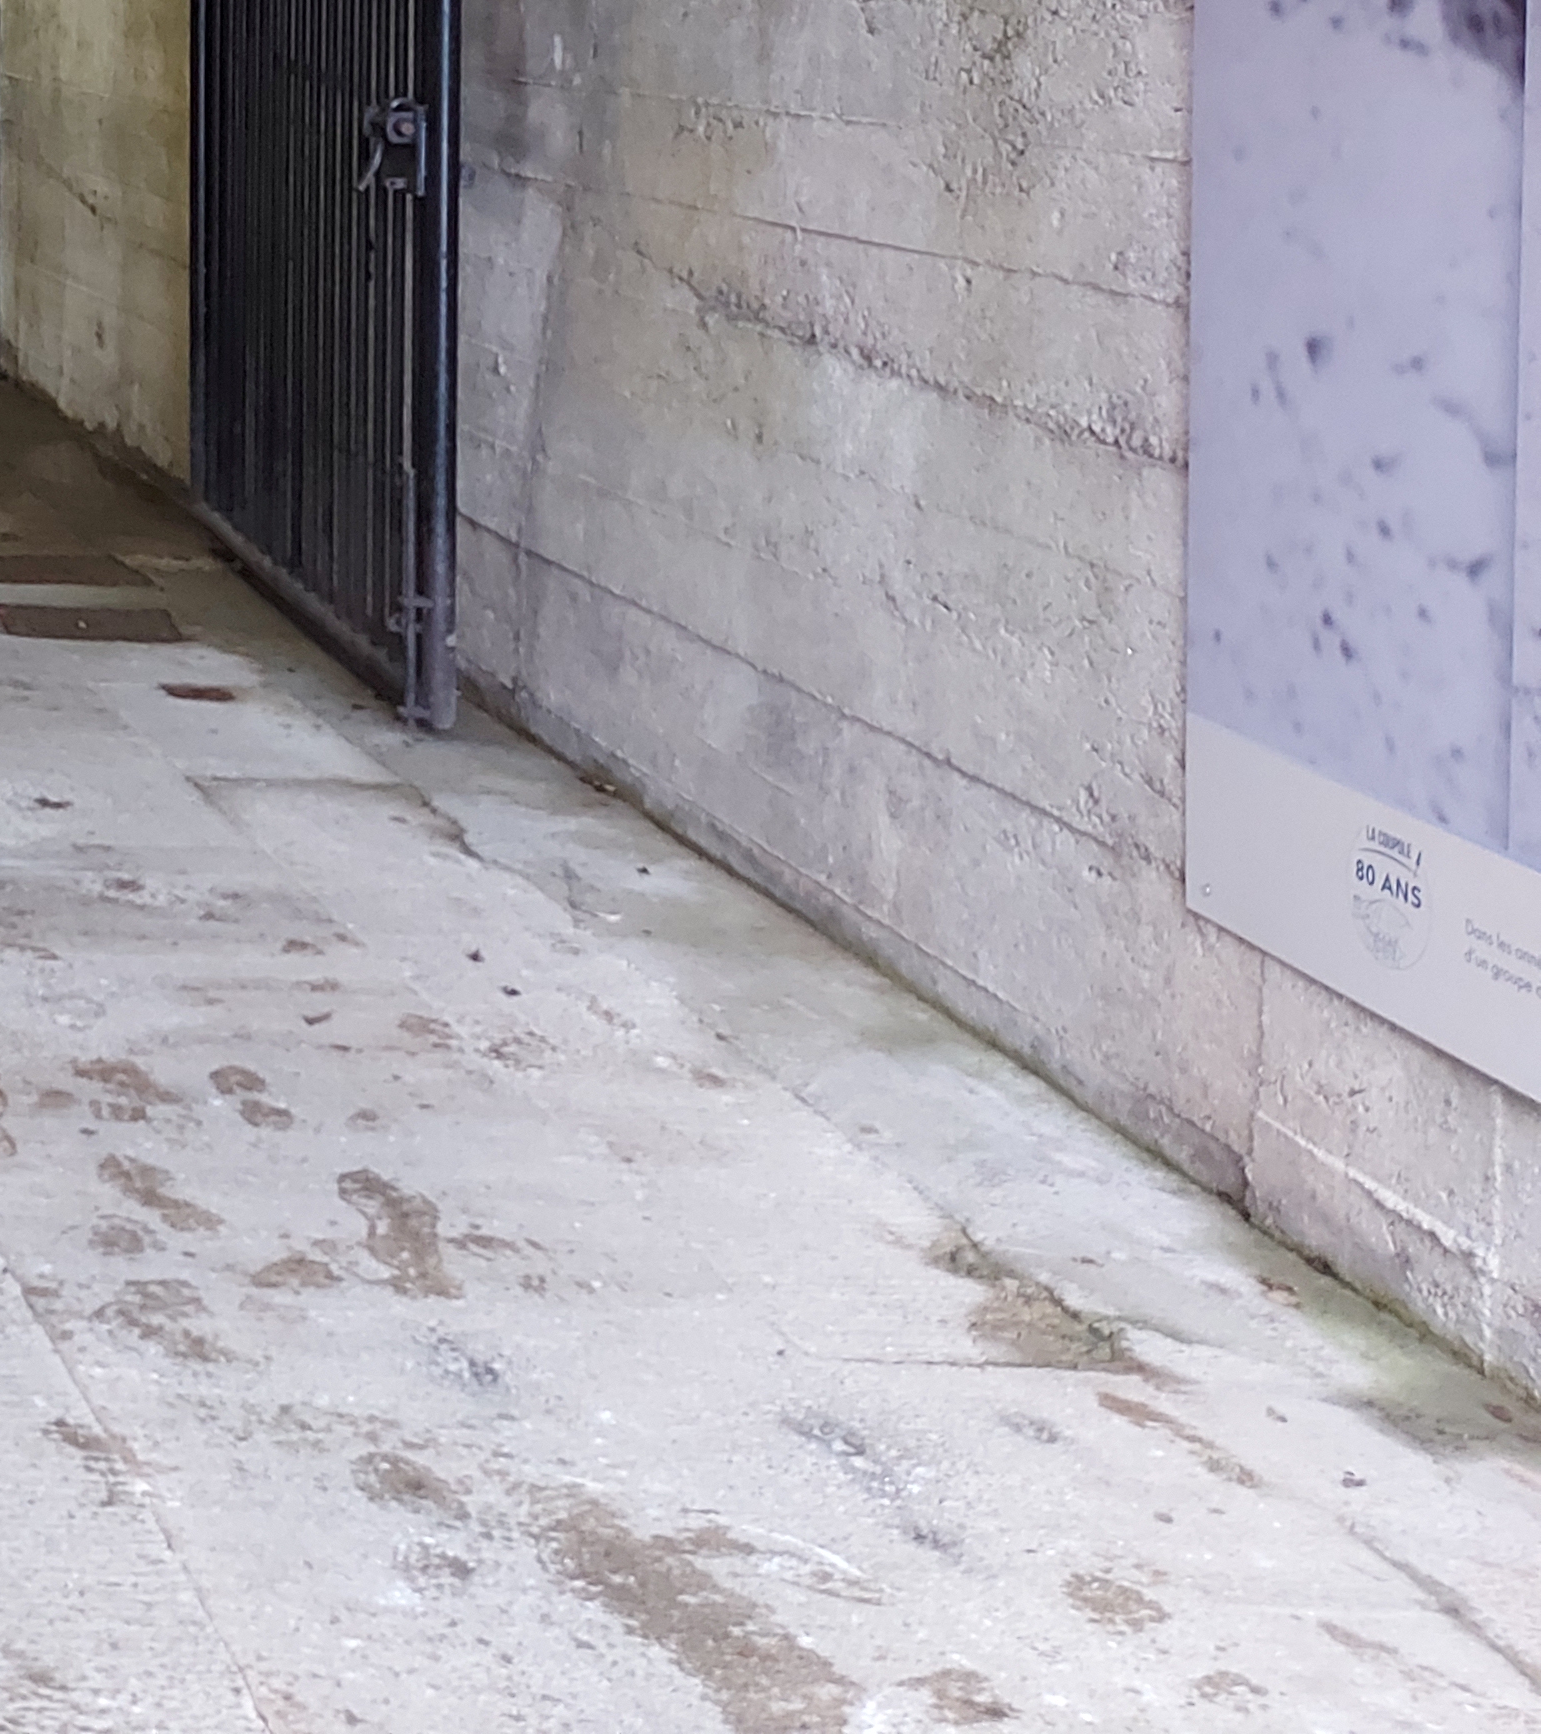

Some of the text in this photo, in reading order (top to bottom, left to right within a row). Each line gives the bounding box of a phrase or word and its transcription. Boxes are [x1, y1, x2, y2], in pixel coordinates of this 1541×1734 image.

[1355, 858, 1422, 909] 80 ANS
[1465, 918, 1494, 946] Dans
